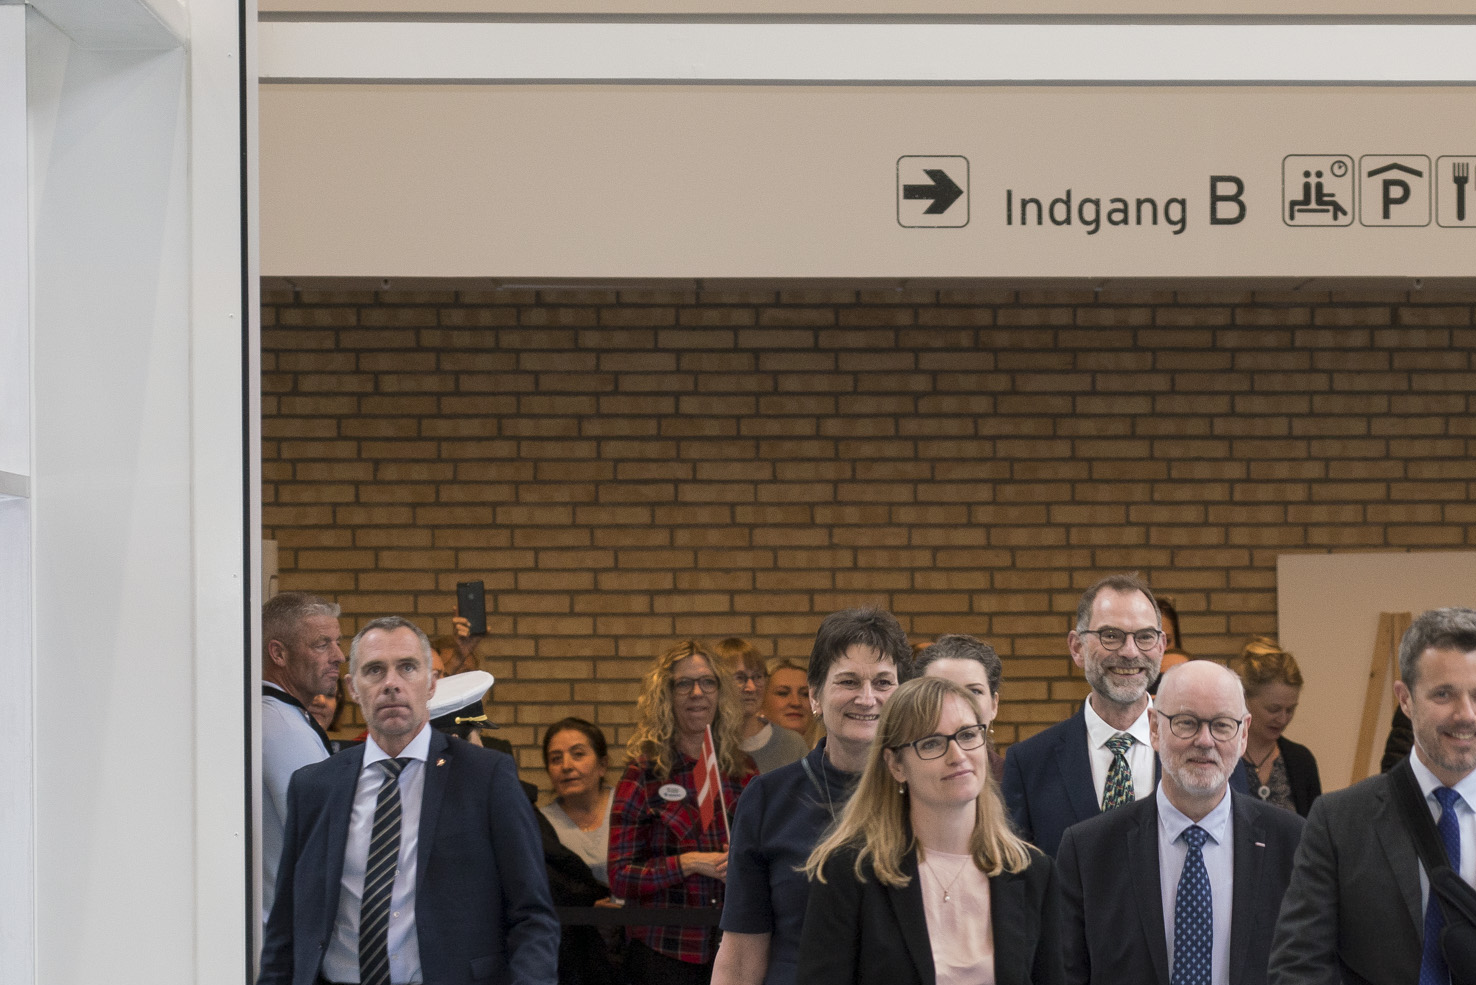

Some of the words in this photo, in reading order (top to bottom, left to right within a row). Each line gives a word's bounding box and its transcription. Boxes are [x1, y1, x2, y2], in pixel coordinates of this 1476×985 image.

[1006, 189, 1187, 236] Indgang
[1209, 175, 1247, 226] B
[1382, 178, 1411, 220] P
